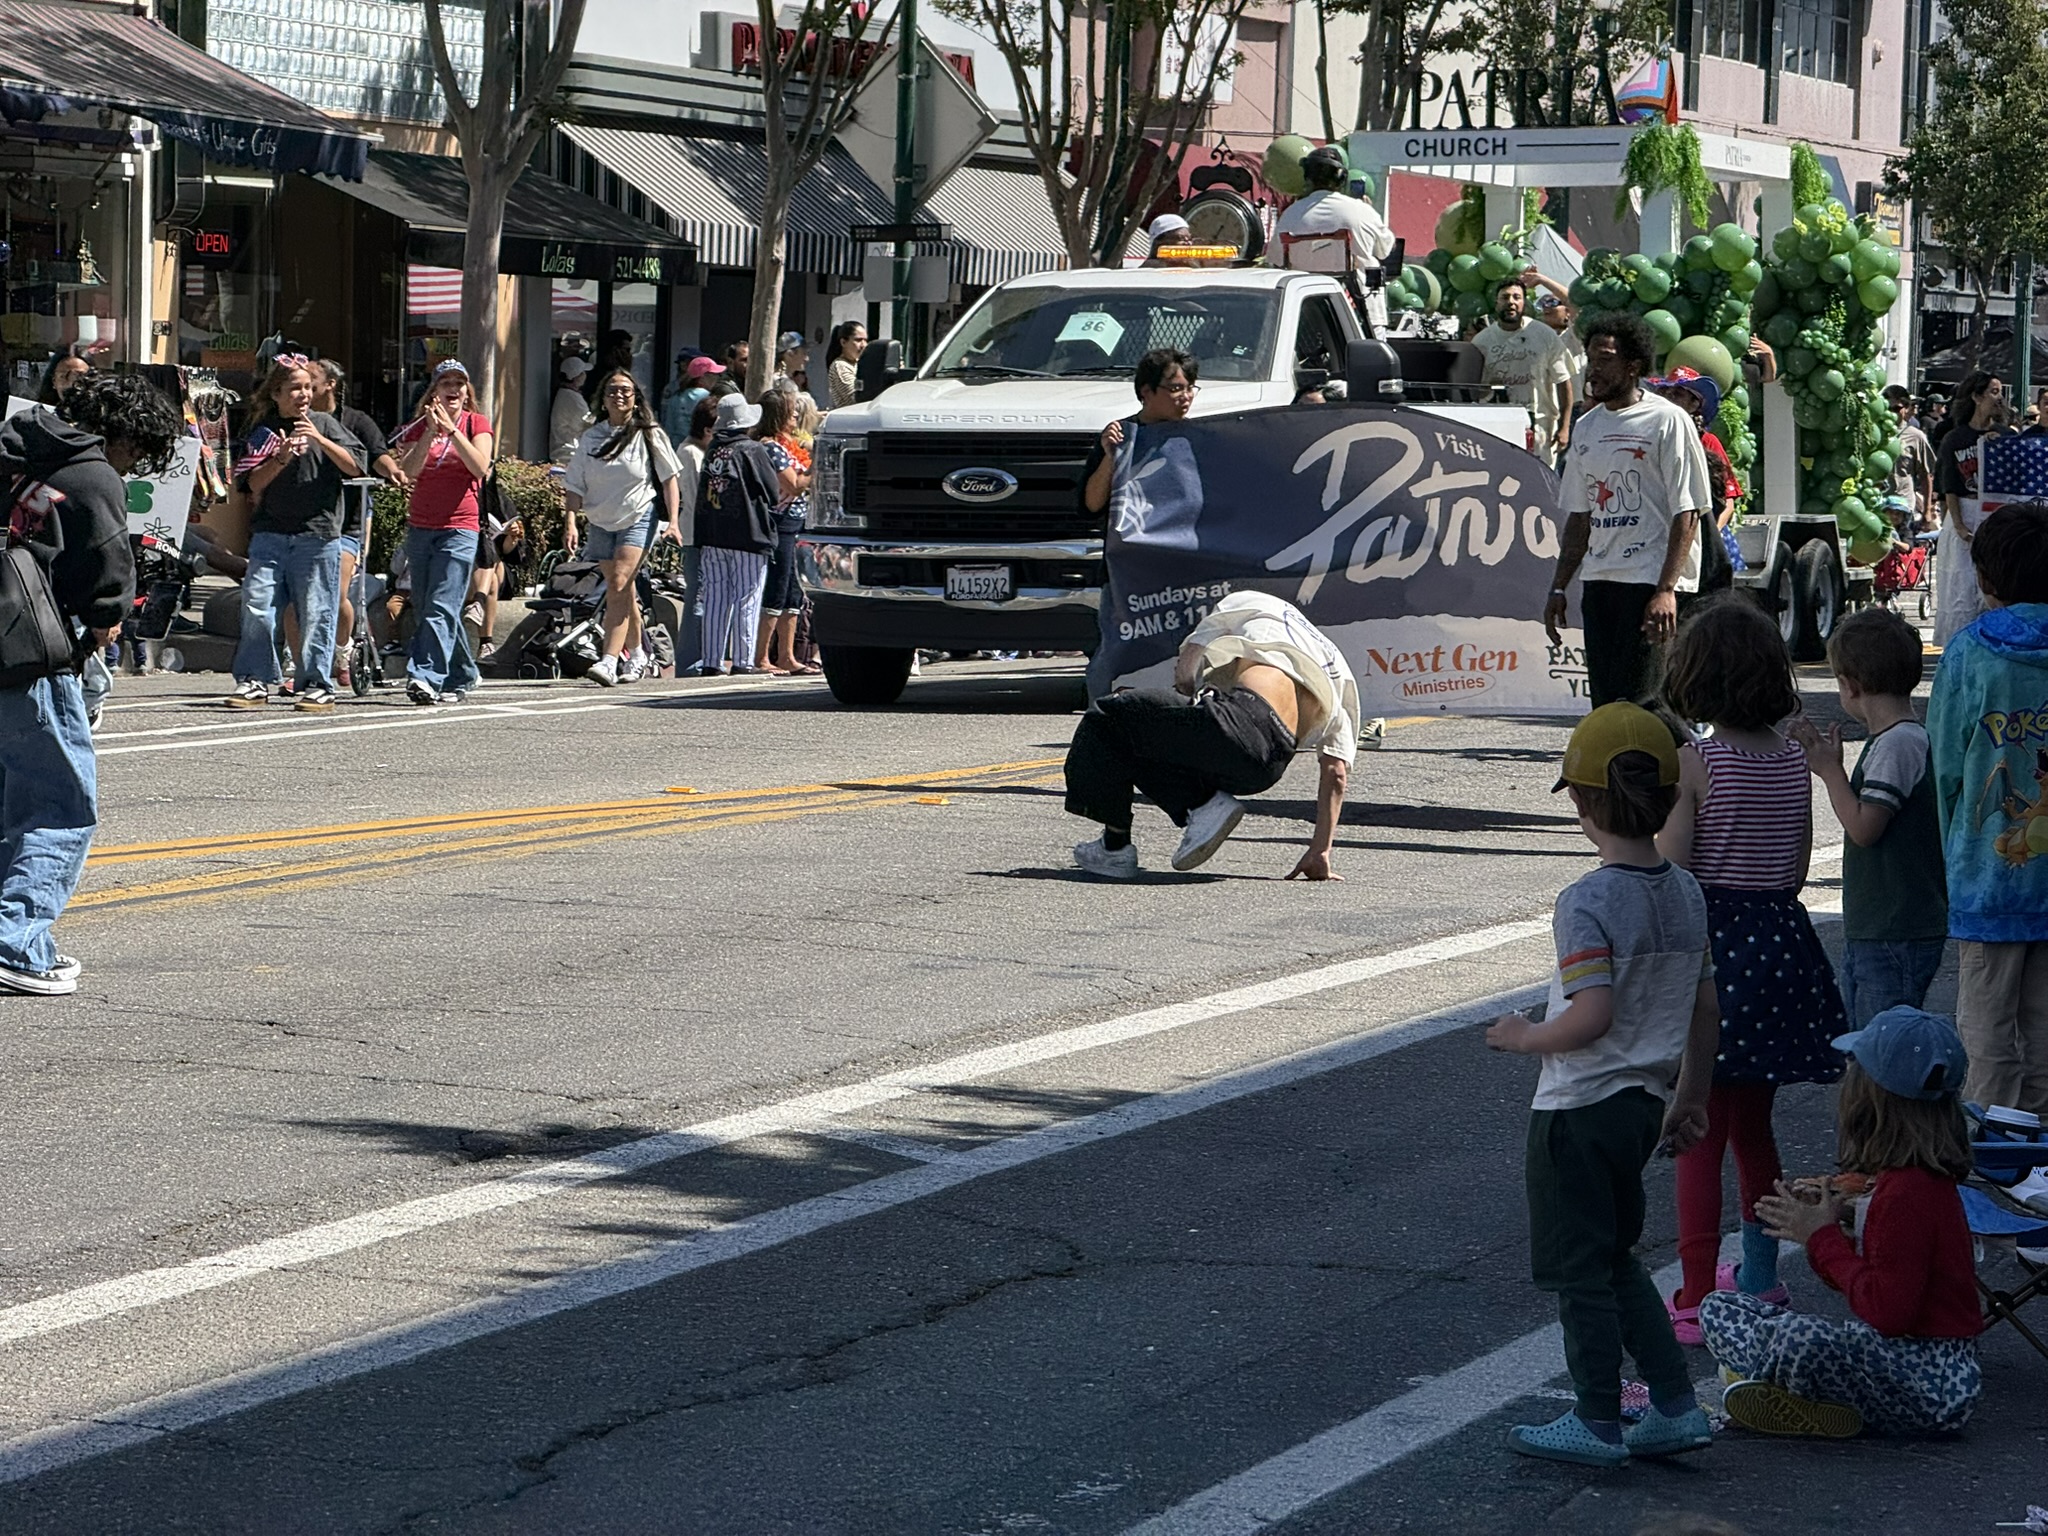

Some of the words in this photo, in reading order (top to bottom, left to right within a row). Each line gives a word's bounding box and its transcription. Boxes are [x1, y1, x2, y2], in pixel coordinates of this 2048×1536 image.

[1404, 136, 1508, 158] CHURCH
[195, 233, 230, 253] OPEN
[541, 243, 576, 274] Lola's
[616, 256, 661, 280] 521-4488
[1080, 320, 1106, 333] 86
[902, 414, 995, 424] SUPER
[1000, 414, 1076, 424] DUTY
[1434, 431, 1487, 462] Visit
[960, 474, 997, 493] Ford
[1264, 420, 1562, 606] Patria
[1602, 515, 1640, 528] NEWS
[949, 576, 1009, 598] 14159X2
[1128, 585, 1206, 613] Sundays
[1209, 581, 1231, 598] at
[1119, 613, 1163, 641] 9AM
[1164, 609, 1180, 630] &
[1364, 645, 1446, 677] Next
[1452, 643, 1519, 672] Gen
[1402, 676, 1486, 698] Ministries
